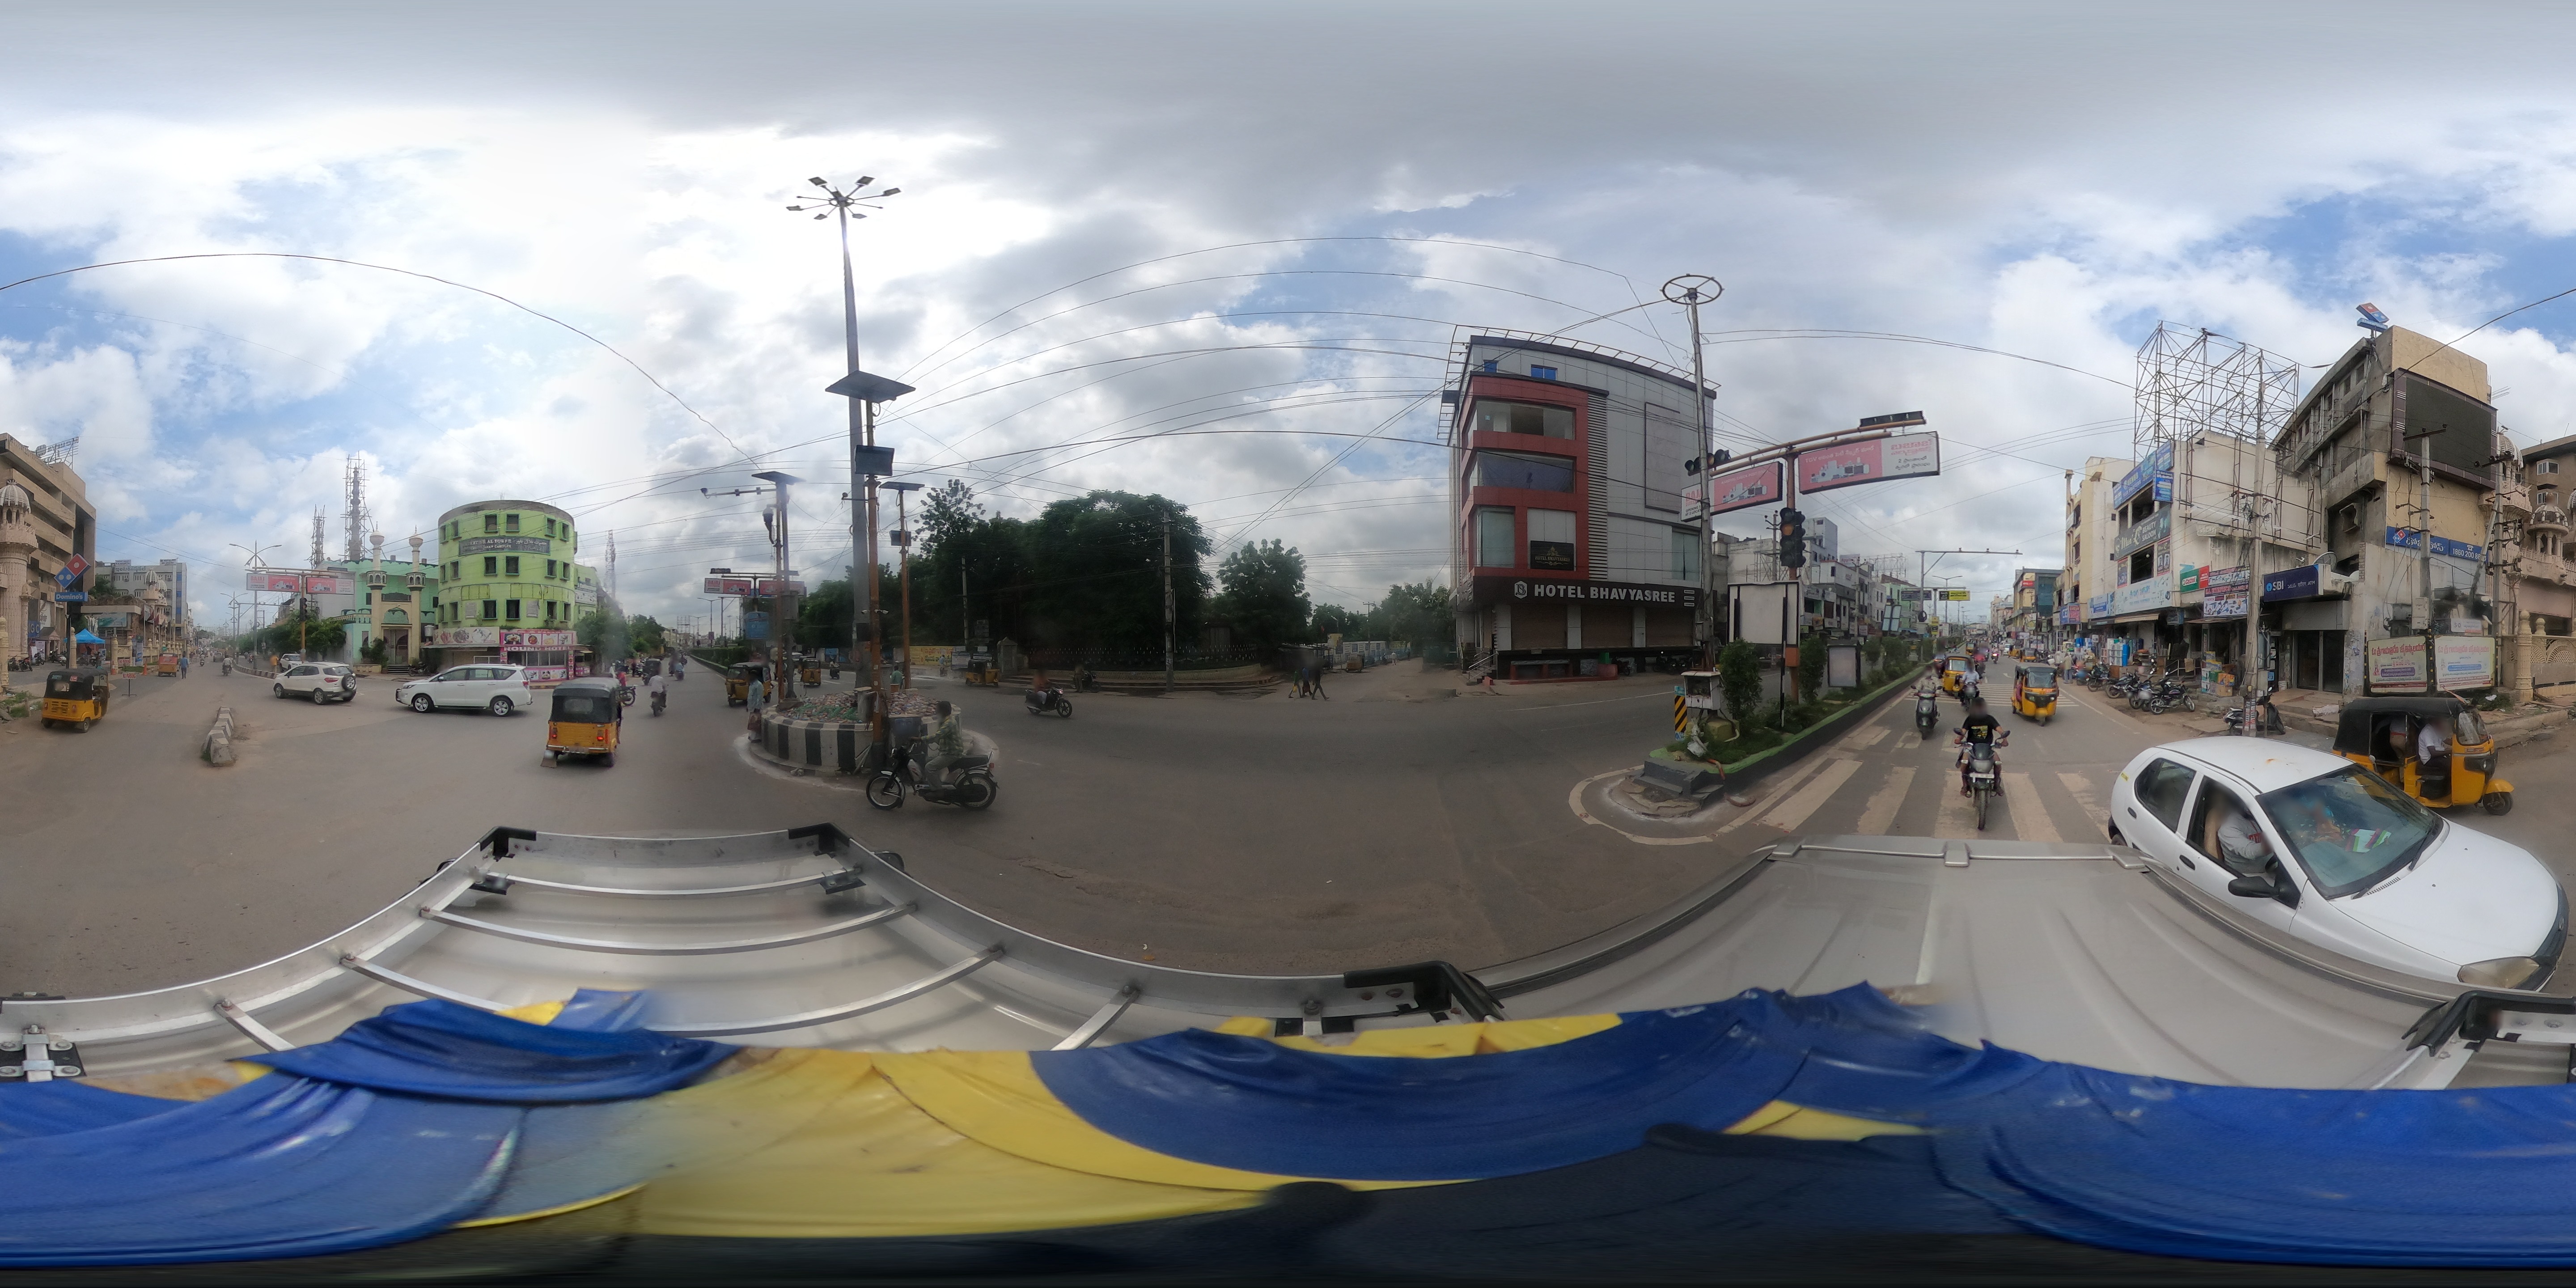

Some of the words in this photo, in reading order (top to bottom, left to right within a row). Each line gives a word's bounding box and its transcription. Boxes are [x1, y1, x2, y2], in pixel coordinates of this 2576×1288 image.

[2143, 521, 2157, 534] BEAUTY
[2142, 529, 2156, 542] SALOON
[2453, 548, 2465, 556] 1860
[2273, 580, 2284, 591] SBI
[1534, 584, 1585, 598] HOTEL
[1590, 587, 1675, 603] BHAVYASREE
